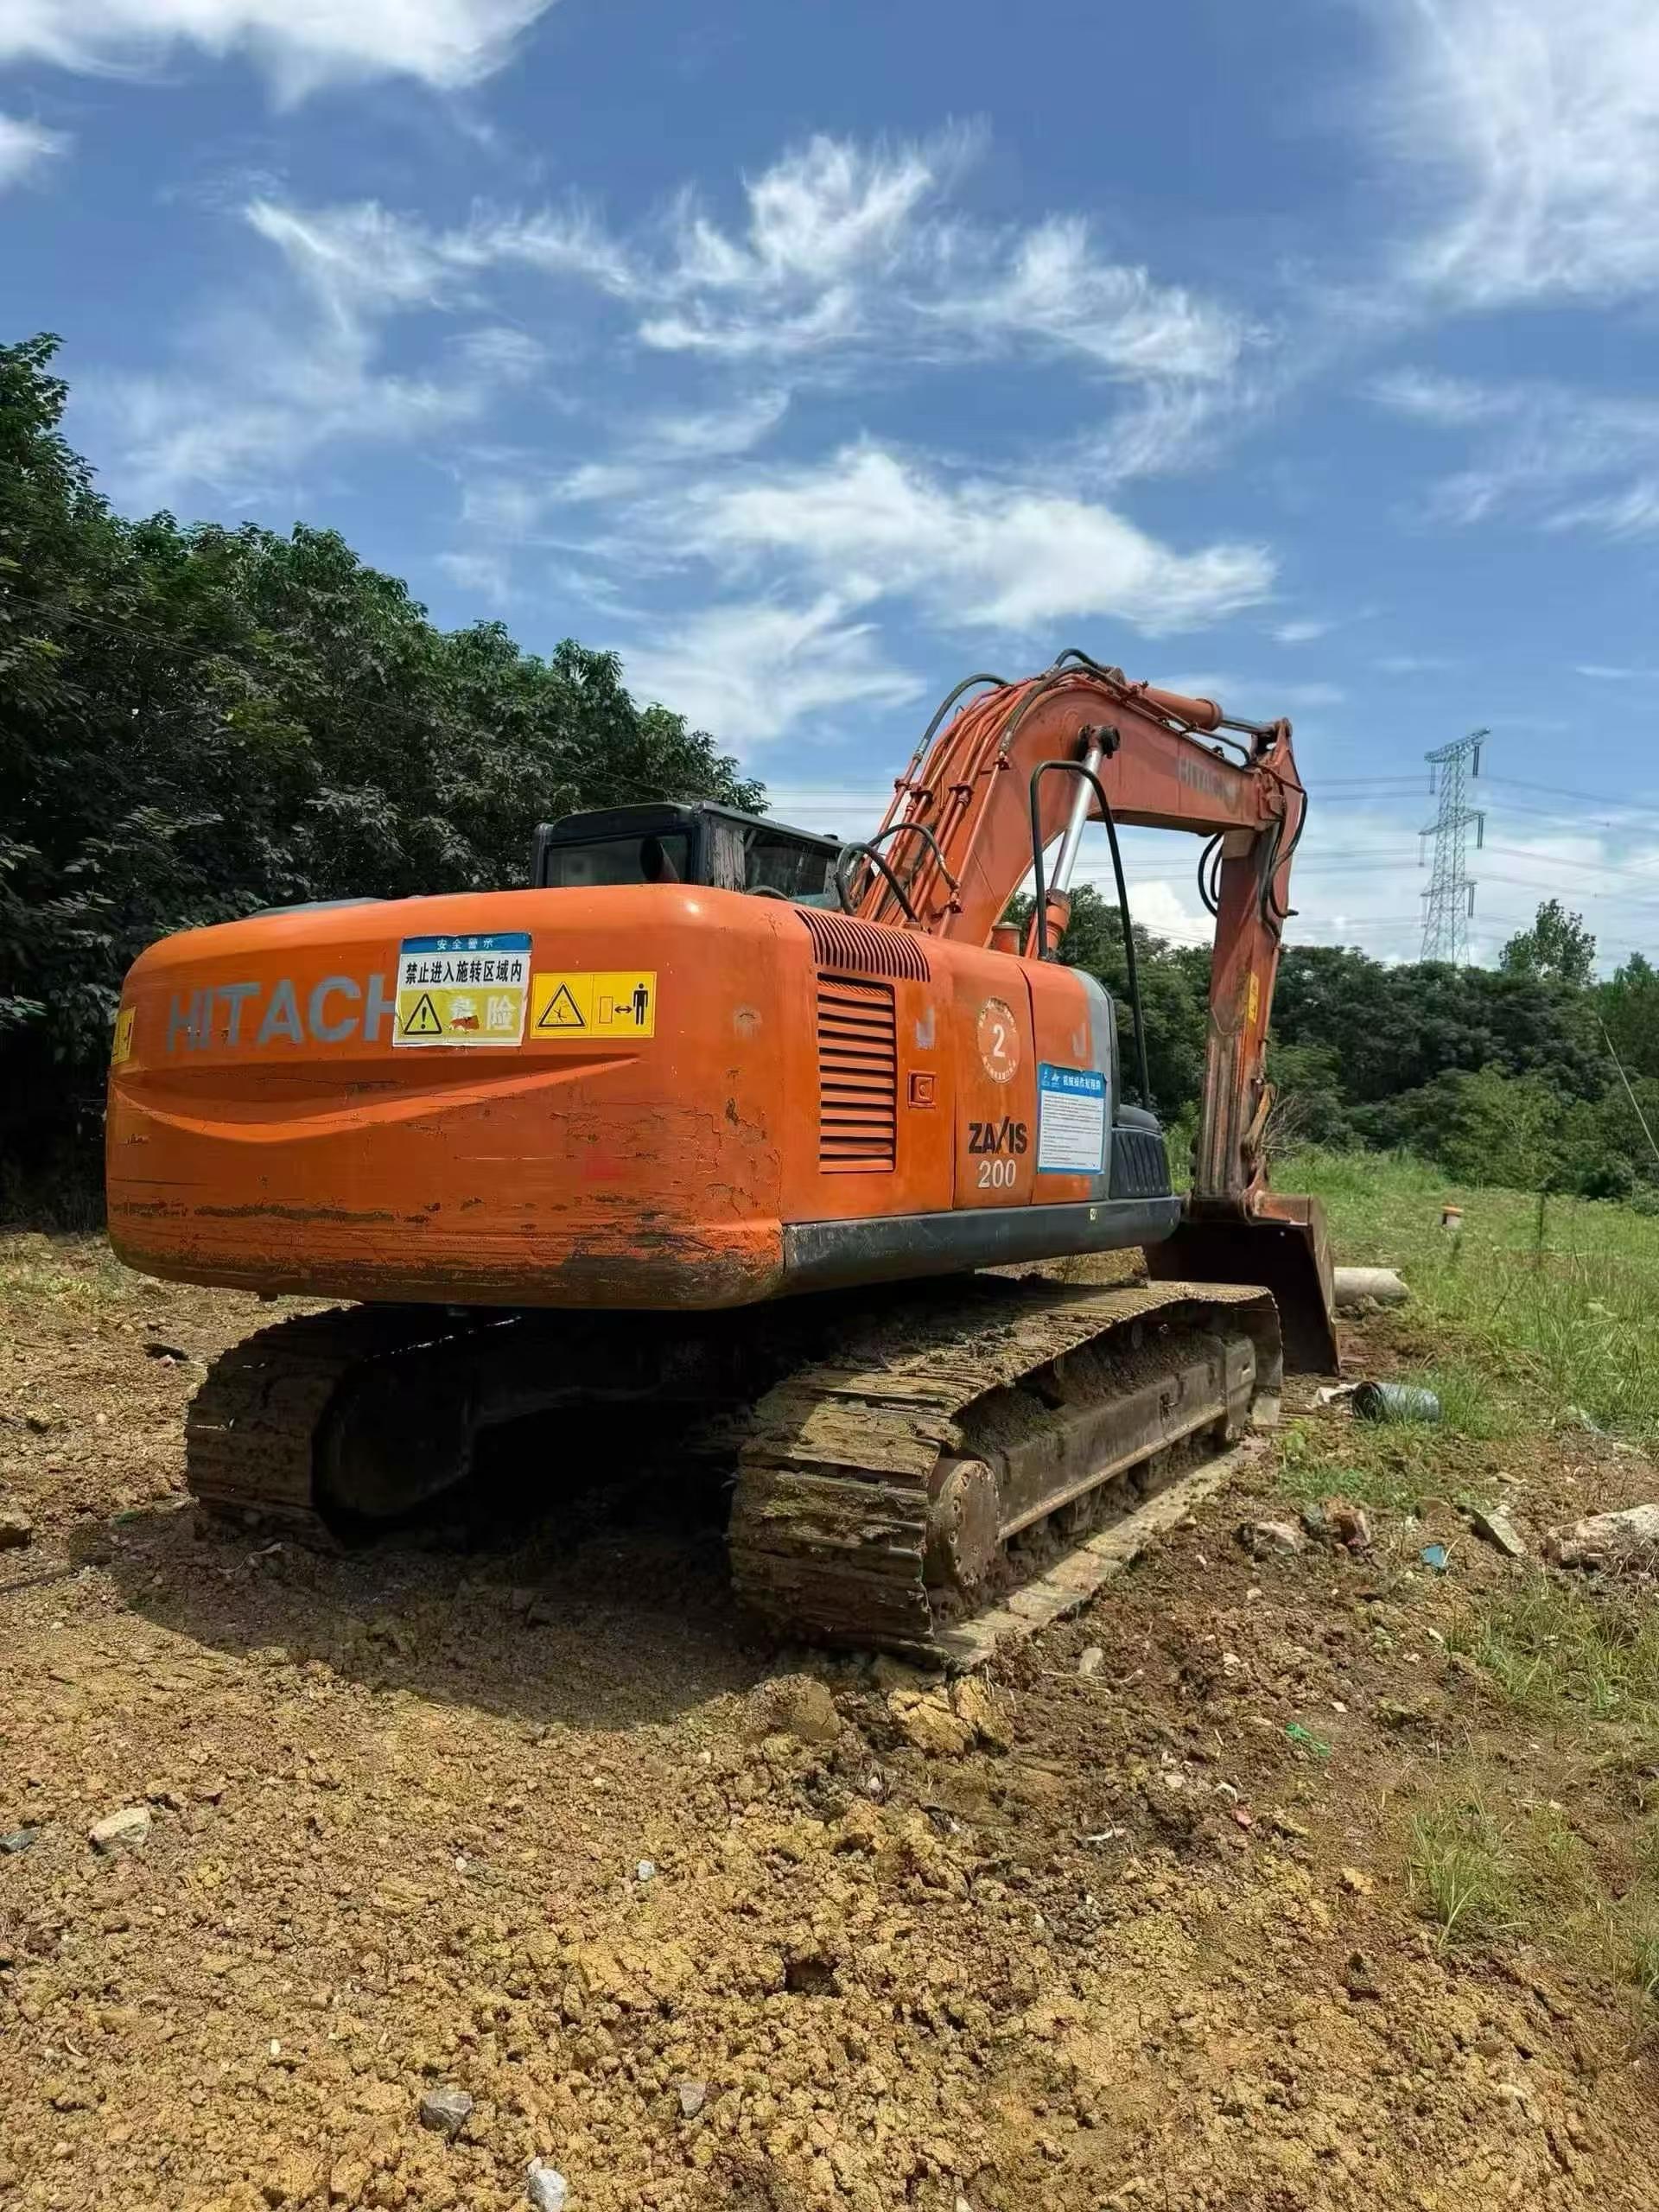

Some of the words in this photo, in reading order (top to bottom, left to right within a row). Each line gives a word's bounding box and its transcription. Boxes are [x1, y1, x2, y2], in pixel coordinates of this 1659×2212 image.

[436, 938, 493, 950] 安全警示
[167, 974, 396, 1053] HITACH
[993, 1024, 1006, 1058] 2
[978, 1160, 1017, 1189] 200
